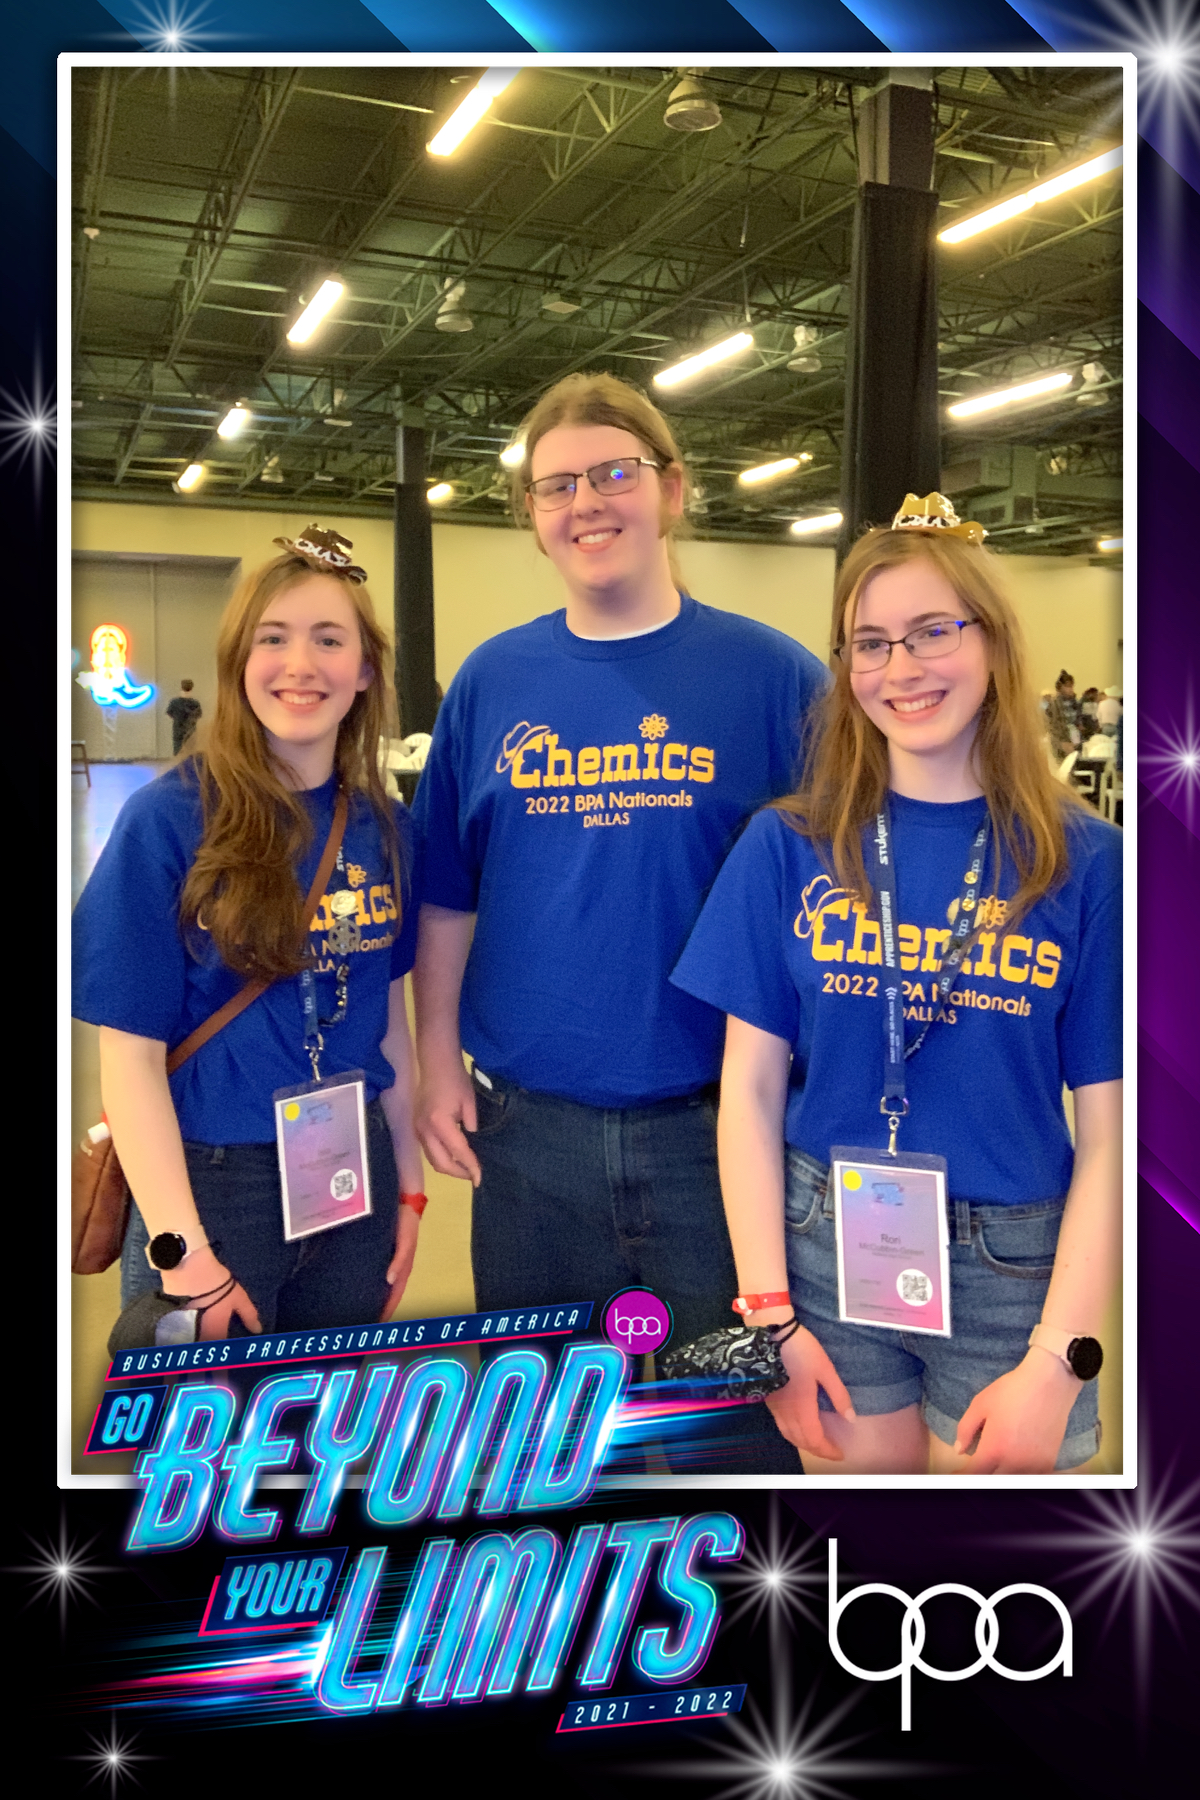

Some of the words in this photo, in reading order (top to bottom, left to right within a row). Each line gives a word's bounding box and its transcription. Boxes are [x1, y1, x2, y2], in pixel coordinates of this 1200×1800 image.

[510, 733, 715, 789] Chemics
[525, 796, 570, 815] 2022
[574, 793, 604, 812] BPA
[609, 789, 693, 809] Nationals
[583, 812, 630, 828] DALLAS
[822, 972, 878, 997] 2022
[901, 981, 926, 1002] PA
